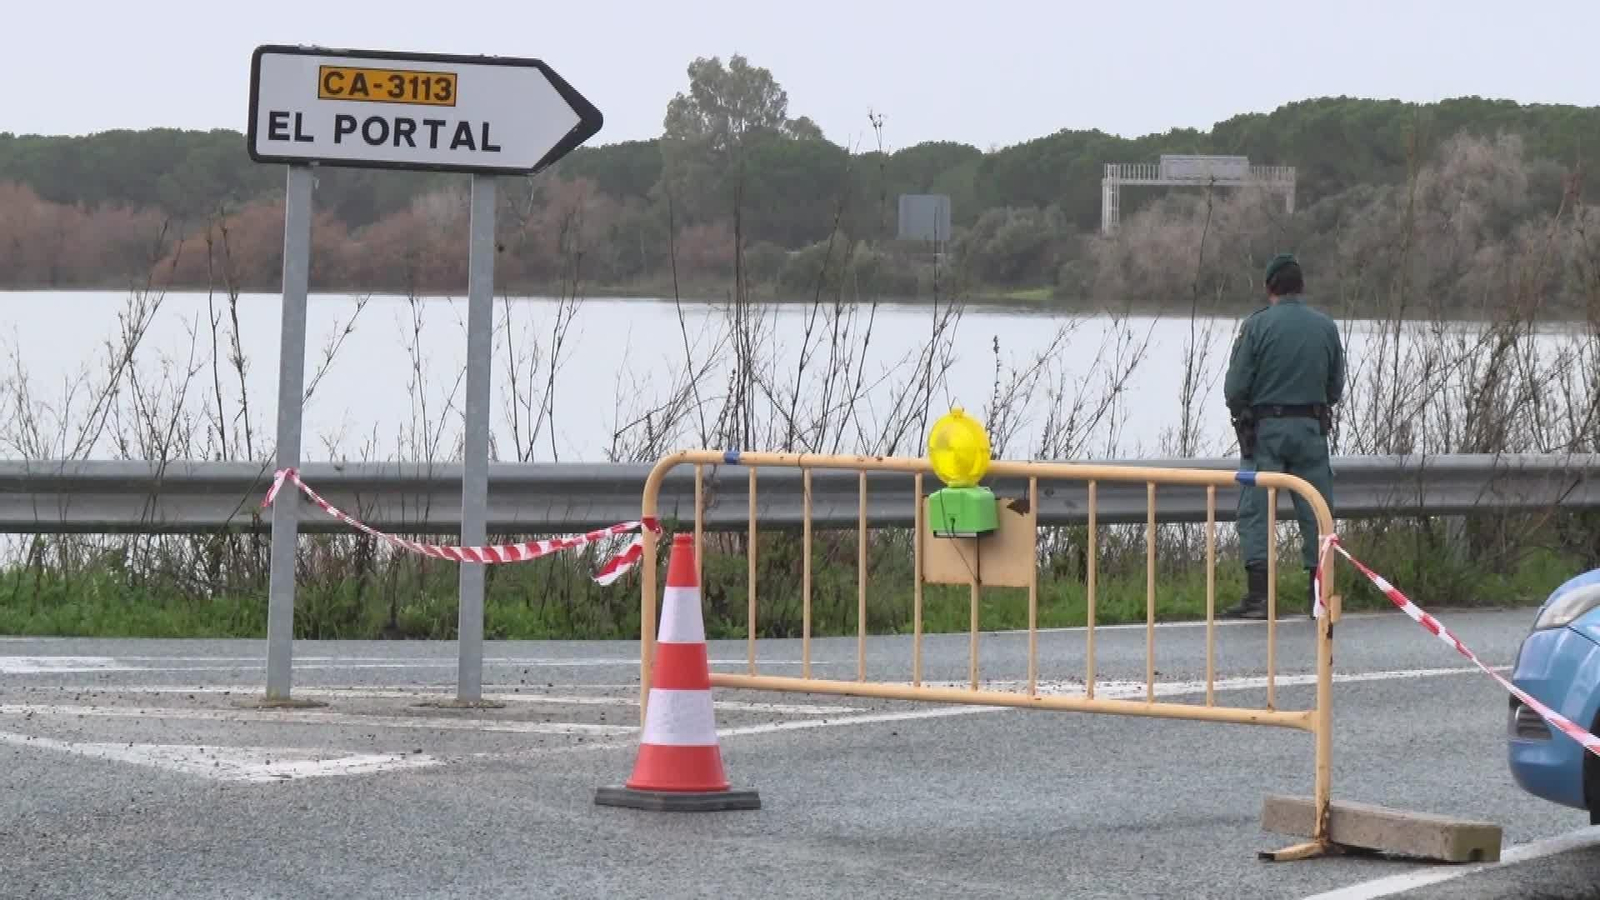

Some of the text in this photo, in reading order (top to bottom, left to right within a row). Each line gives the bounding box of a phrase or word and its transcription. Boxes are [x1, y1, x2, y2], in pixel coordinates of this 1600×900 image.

[323, 71, 452, 101] CA-3113
[268, 111, 501, 152] EL PORTAL
